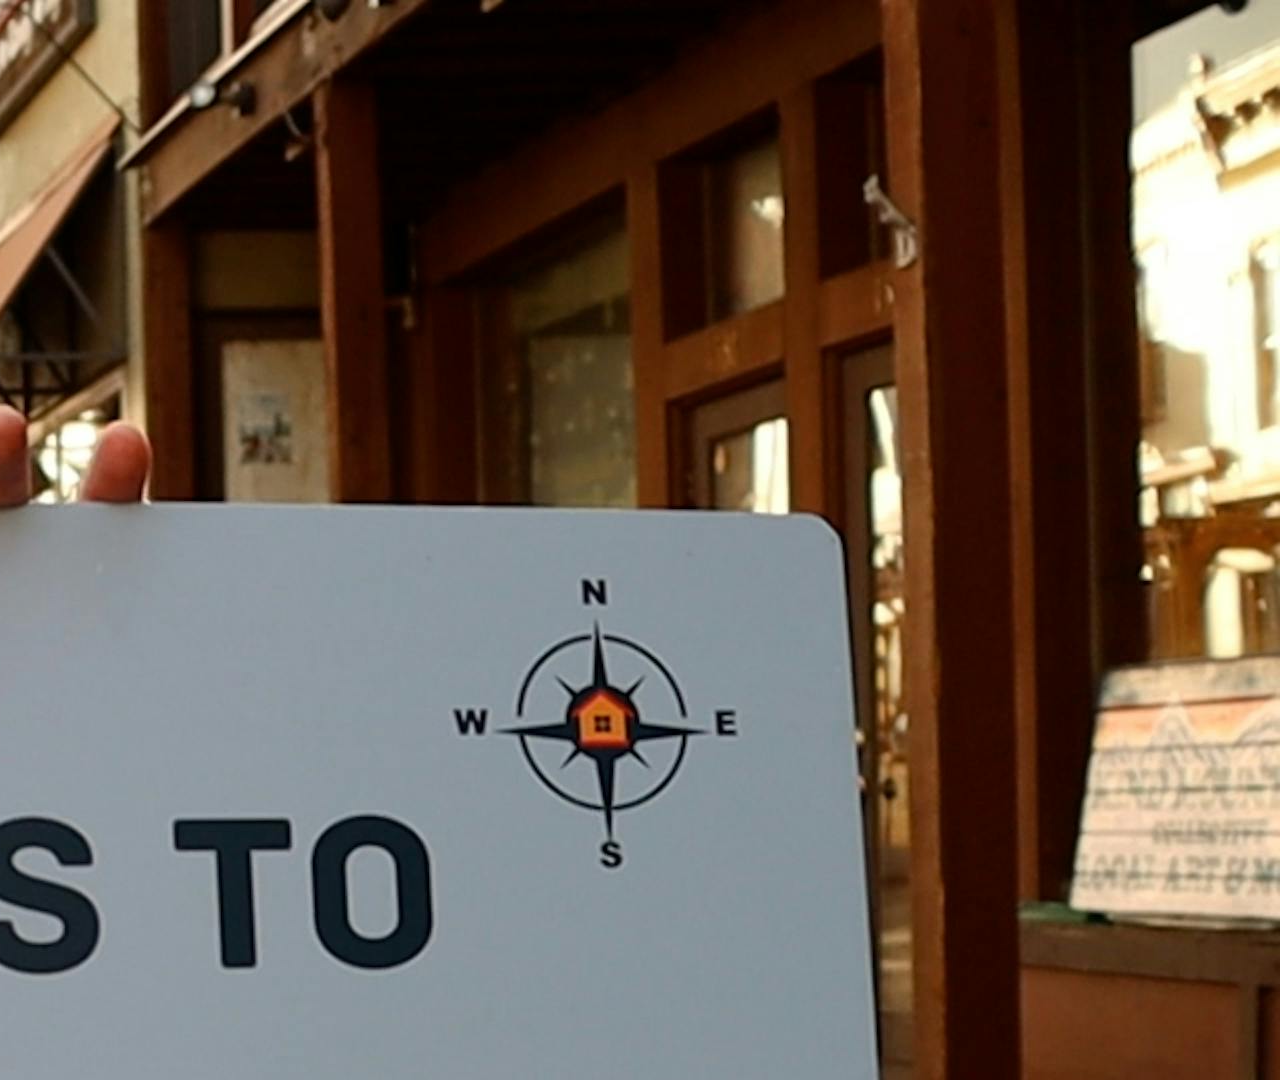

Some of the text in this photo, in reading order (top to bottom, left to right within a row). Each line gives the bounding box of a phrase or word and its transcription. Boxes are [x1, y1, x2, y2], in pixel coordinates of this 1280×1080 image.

[580, 577, 609, 607] N
[452, 707, 489, 737] W
[713, 708, 739, 738] E
[598, 836, 624, 870] S
[171, 813, 435, 972] TO
